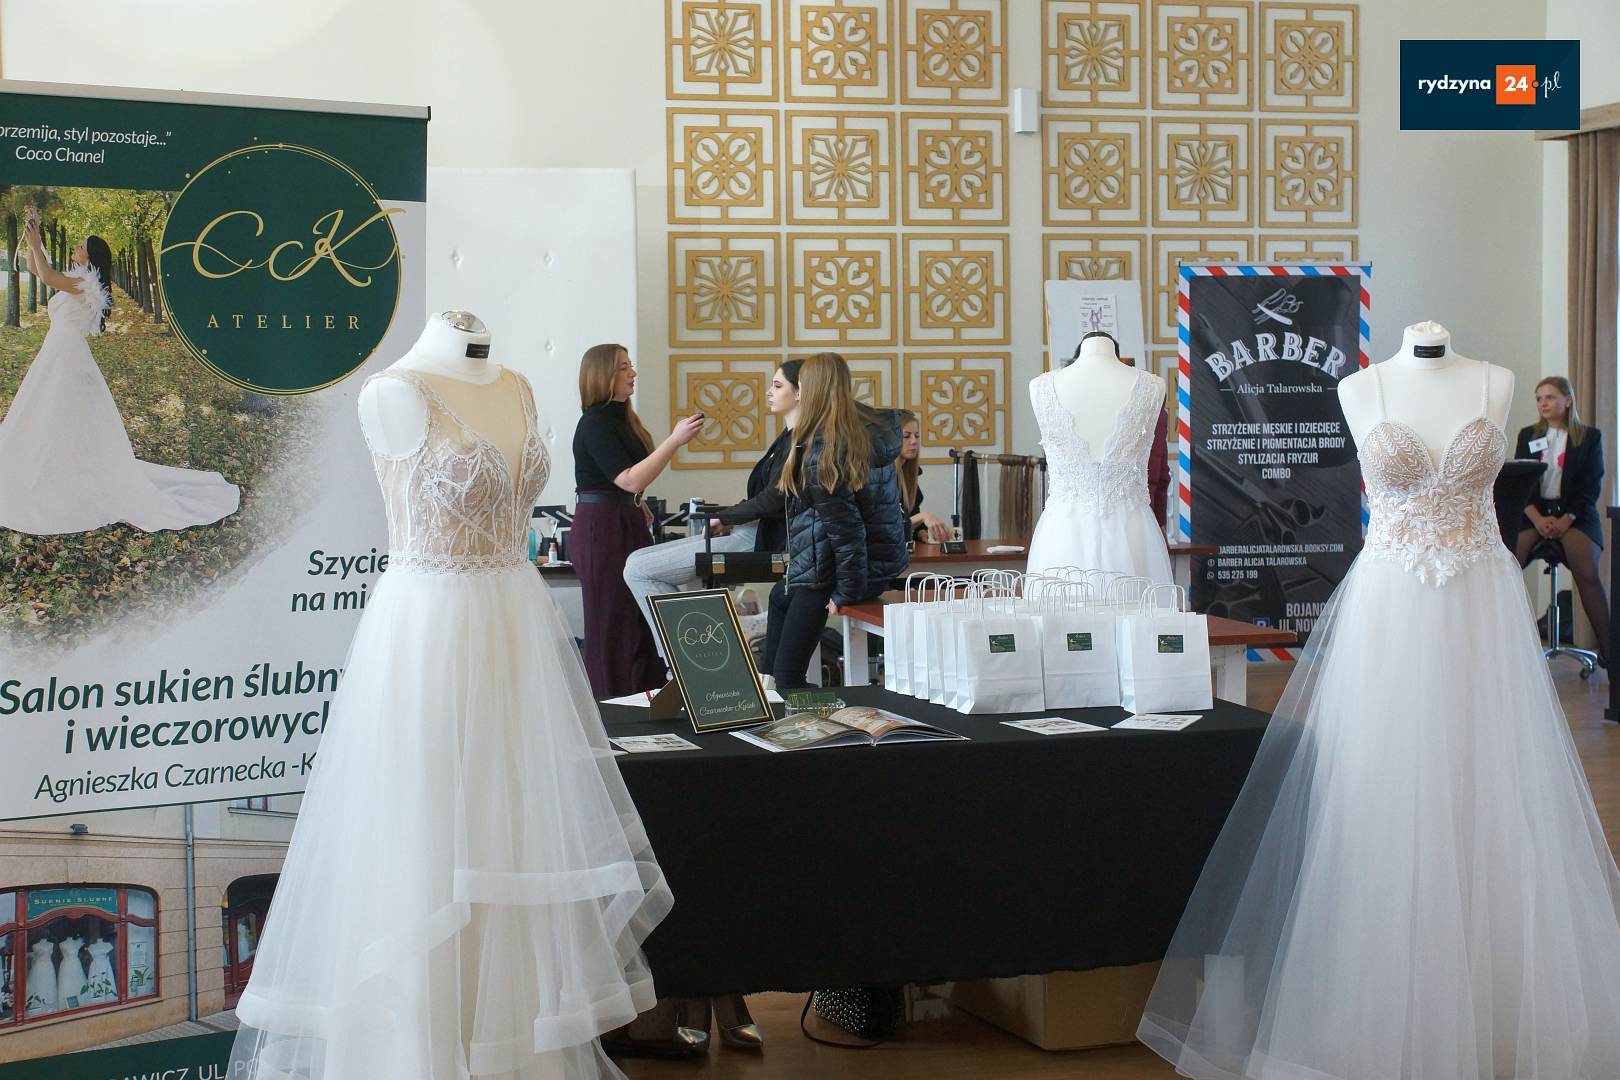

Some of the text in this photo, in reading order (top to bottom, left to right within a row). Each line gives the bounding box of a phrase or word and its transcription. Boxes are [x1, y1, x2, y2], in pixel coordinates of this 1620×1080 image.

[64, 127, 89, 144] styl
[15, 145, 105, 164] Coco Chanel
[207, 313, 361, 330] ATELIER
[1204, 331, 1347, 383] BARBER
[1237, 382, 1323, 395] Alicja Talarowska
[1212, 421, 1261, 435] STRZYŻENIE
[1262, 422, 1293, 436] MĘSKIE
[1299, 422, 1341, 435] DZIECIĘCE
[1207, 436, 1256, 450] STRZYŻENIE
[1262, 437, 1317, 449] PIGMENTACJA
[1319, 437, 1346, 449] BRODY
[1238, 452, 1319, 465] STYLIZACJA FRYZUR
[1262, 468, 1291, 479] COMBO
[307, 547, 390, 580] Szycie
[1217, 556, 1307, 567] BARBER ALICJA TALAROWSKA
[1231, 570, 1245, 580] 275
[1246, 569, 1258, 580] 199
[291, 583, 371, 612] na mi
[0, 660, 343, 715] Salon sukien ślubn
[65, 719, 75, 754] i
[33, 765, 159, 803] Agnieszka
[164, 755, 286, 788] Czarnecka
